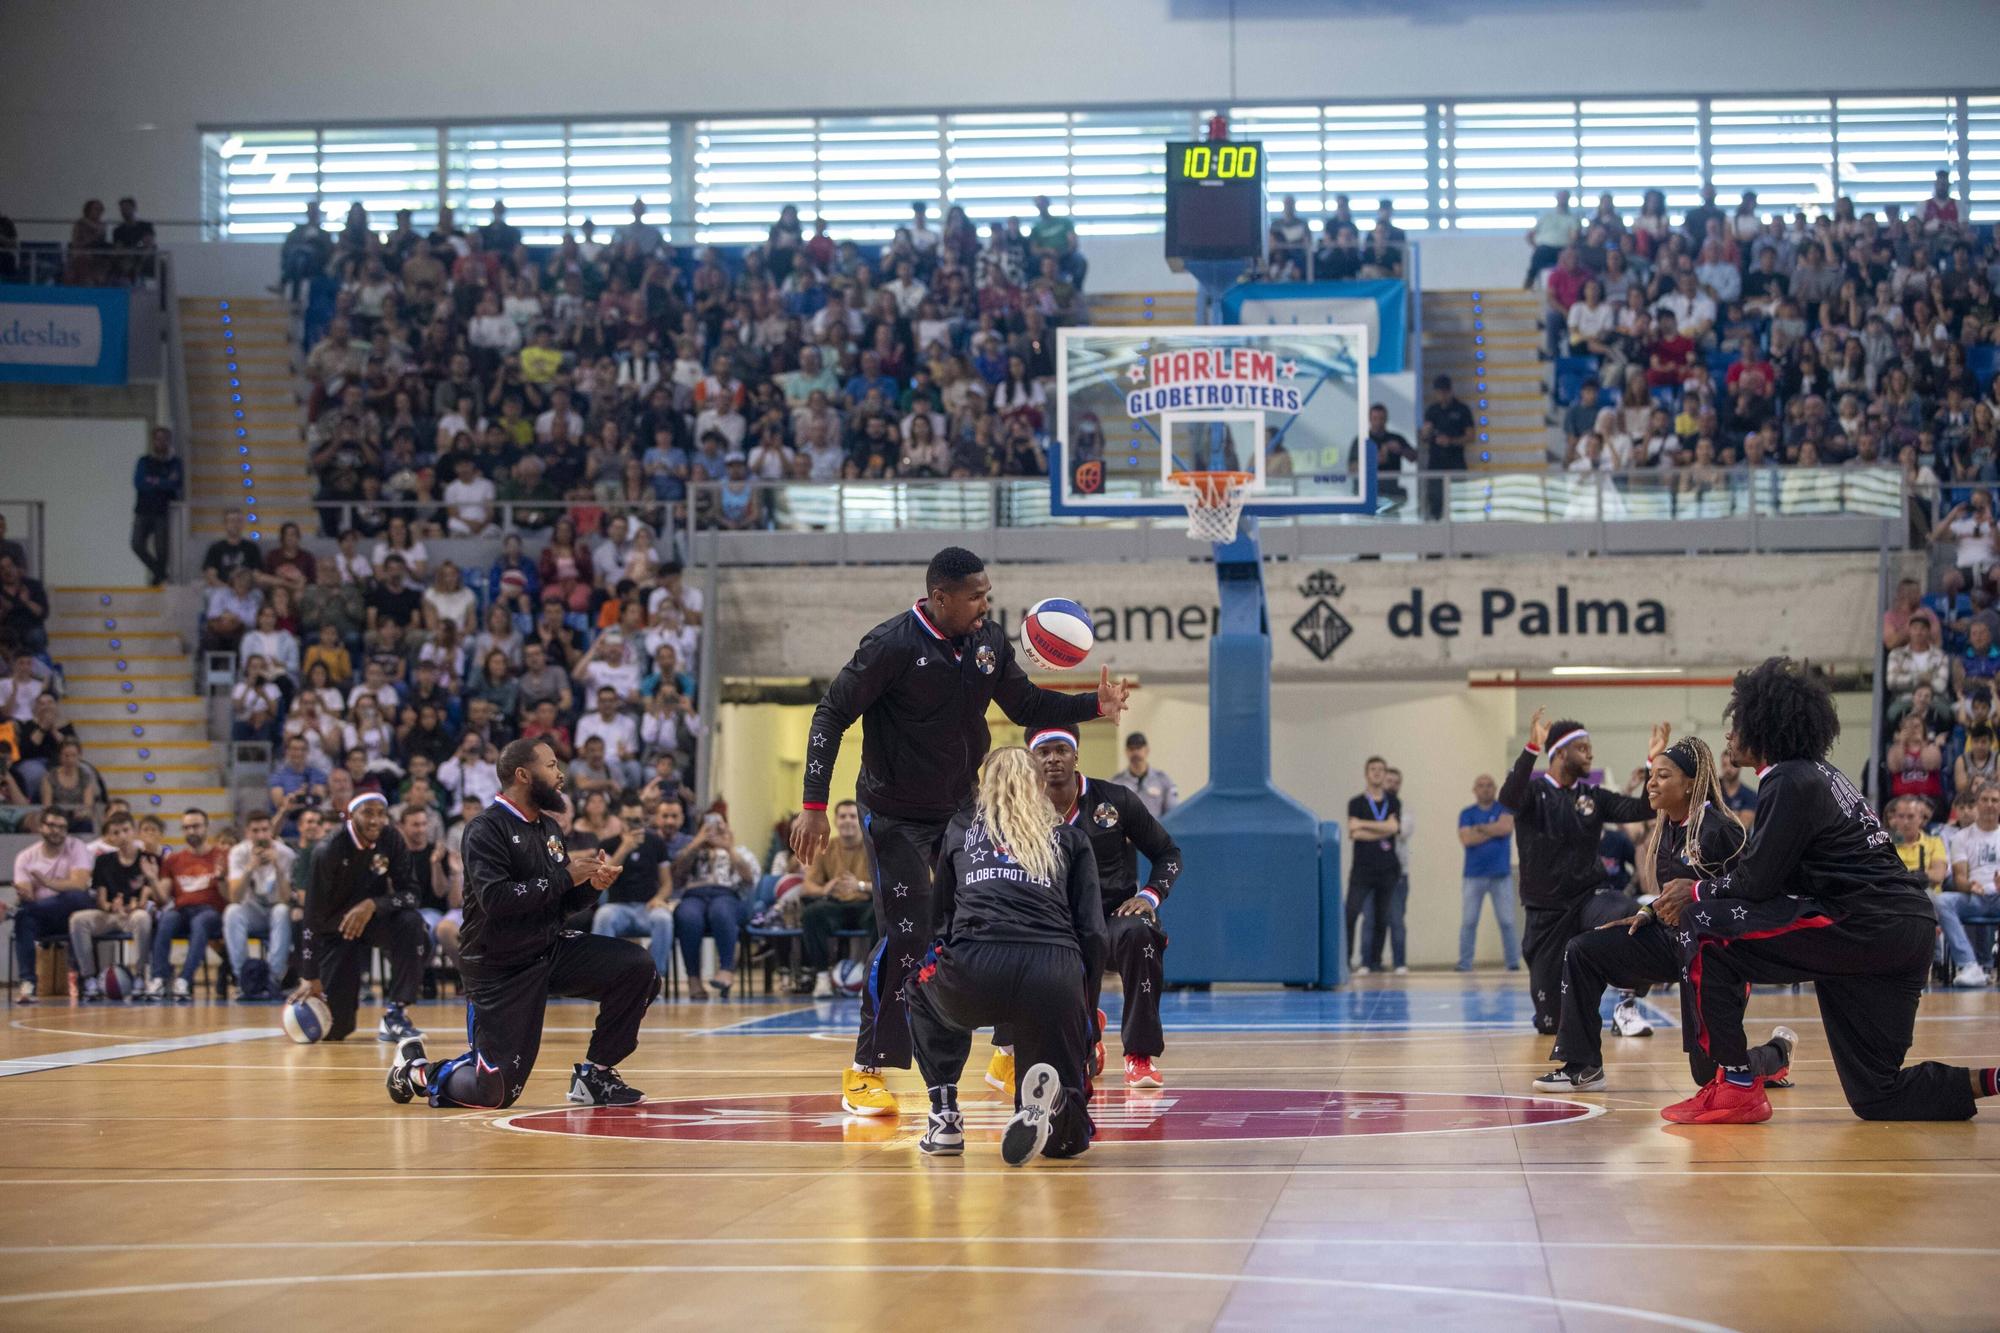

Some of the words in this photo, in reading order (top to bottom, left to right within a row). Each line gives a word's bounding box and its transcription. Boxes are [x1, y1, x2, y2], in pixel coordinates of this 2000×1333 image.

[1183, 147, 1257, 178] 10:00
[0, 319, 81, 348] deslas
[1153, 351, 1275, 386] HARLEM
[1129, 384, 1299, 414] GLOBETROTTERS
[1388, 588, 1462, 638] de
[1482, 585, 1667, 638] Palma
